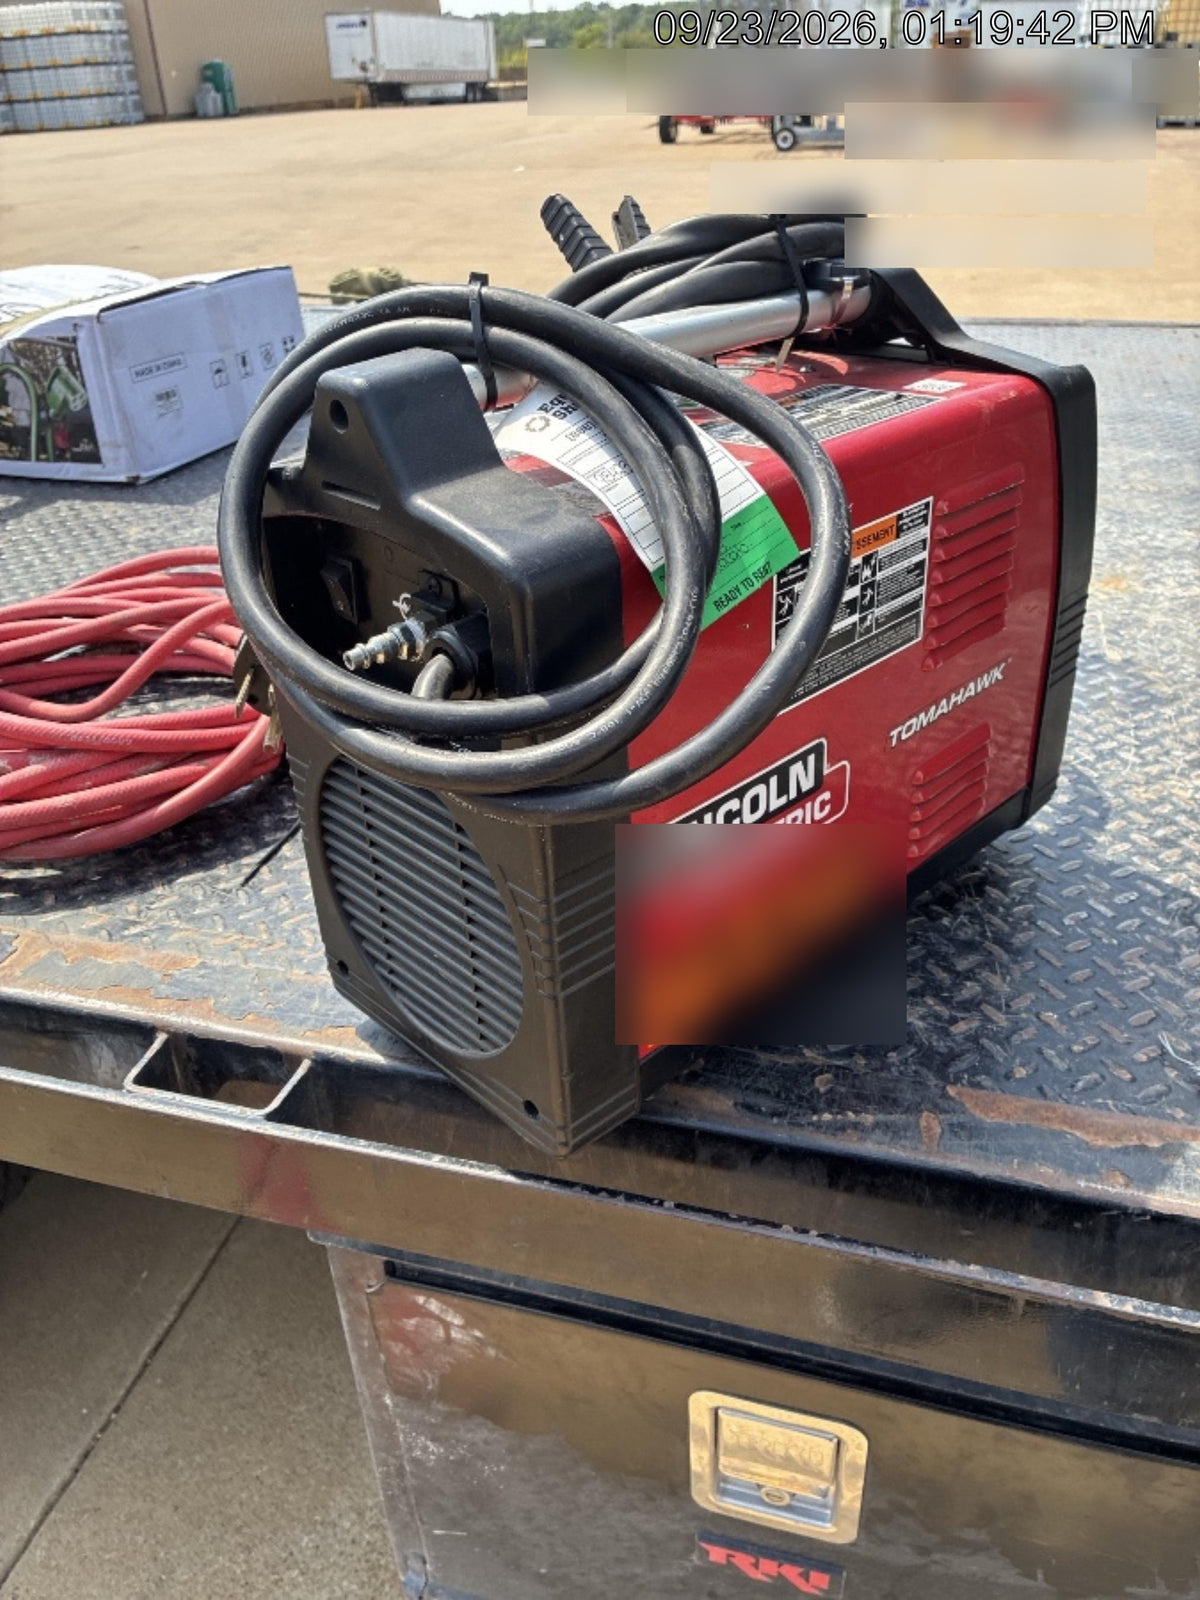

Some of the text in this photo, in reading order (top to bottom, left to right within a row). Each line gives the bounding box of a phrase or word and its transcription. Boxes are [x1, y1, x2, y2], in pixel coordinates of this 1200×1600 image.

[713, 584, 742, 612] READY
[741, 575, 755, 592] TO
[889, 662, 1007, 748] TOMAHAWK
